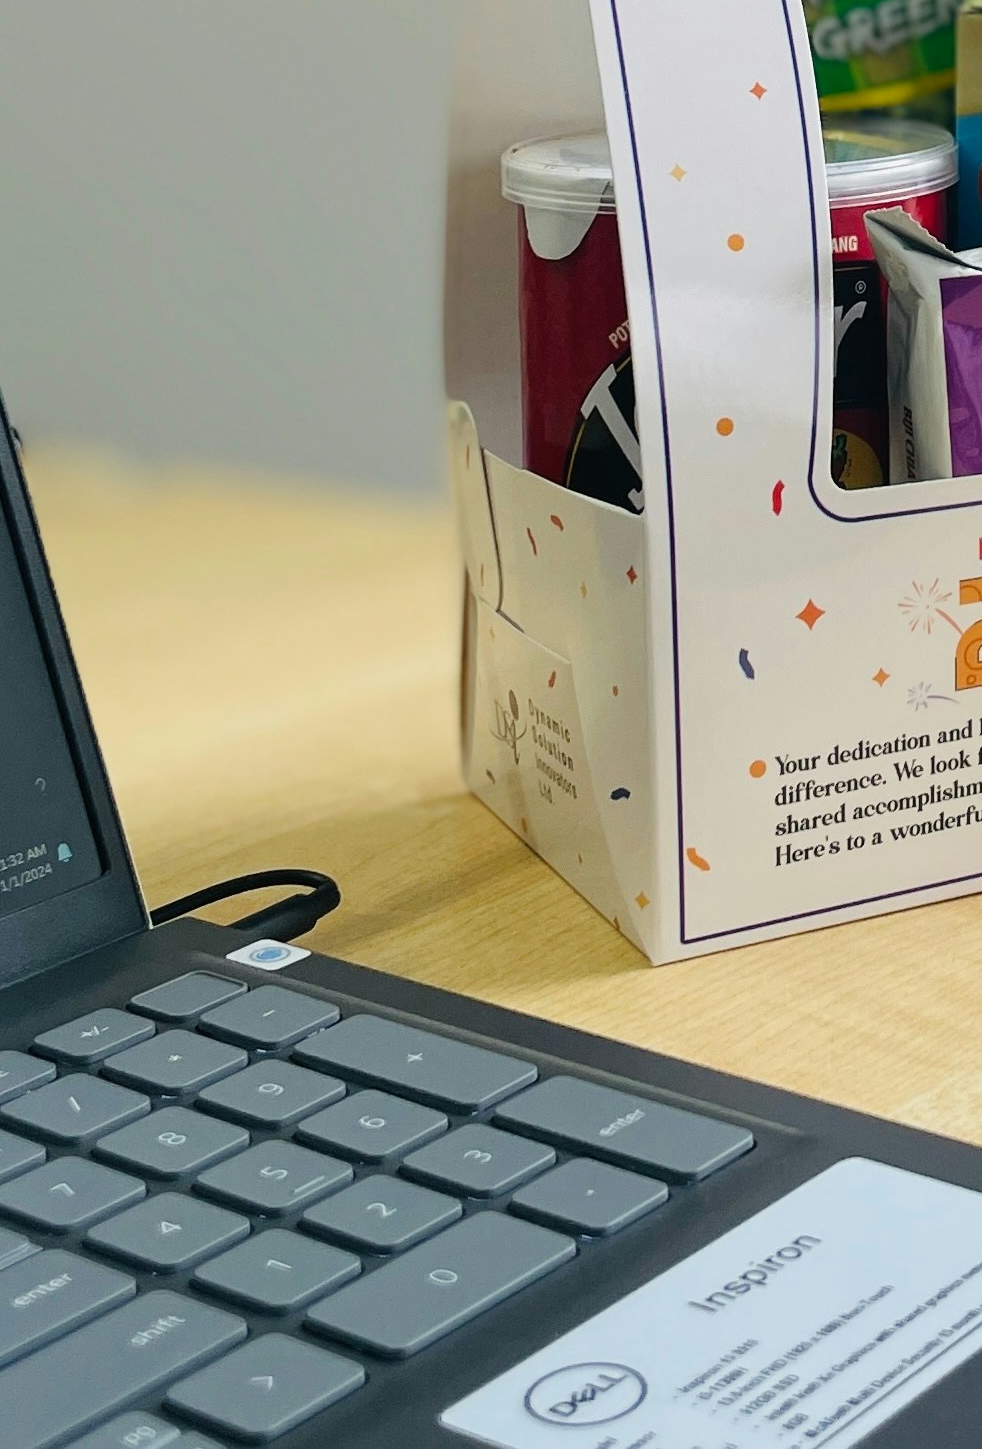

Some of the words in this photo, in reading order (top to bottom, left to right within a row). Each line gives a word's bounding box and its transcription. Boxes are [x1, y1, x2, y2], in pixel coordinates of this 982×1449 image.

[528, 697, 571, 743] Dynamic
[775, 753, 820, 776] Your
[827, 733, 930, 766] dedication
[937, 719, 972, 744] and
[774, 773, 887, 806] difference.
[893, 758, 924, 782] We
[930, 750, 971, 775] look
[774, 803, 846, 836] shared
[28, 843, 48, 861] AM
[775, 835, 840, 867] Here's
[847, 834, 865, 851] to
[871, 832, 883, 846] a
[258, 1083, 284, 1096] 9
[358, 1115, 385, 1129] 6
[158, 1132, 187, 1145] 8
[463, 1150, 492, 1163] 3
[259, 1166, 288, 1181] 5
[51, 1182, 76, 1196] 7
[366, 1202, 397, 1218] 2
[160, 1221, 182, 1234] 4
[266, 1259, 292, 1270] 1
[688, 1234, 822, 1313] Inspiron
[12, 1272, 73, 1308] enter
[130, 1315, 186, 1346] shift
[549, 1372, 629, 1417] DELL
